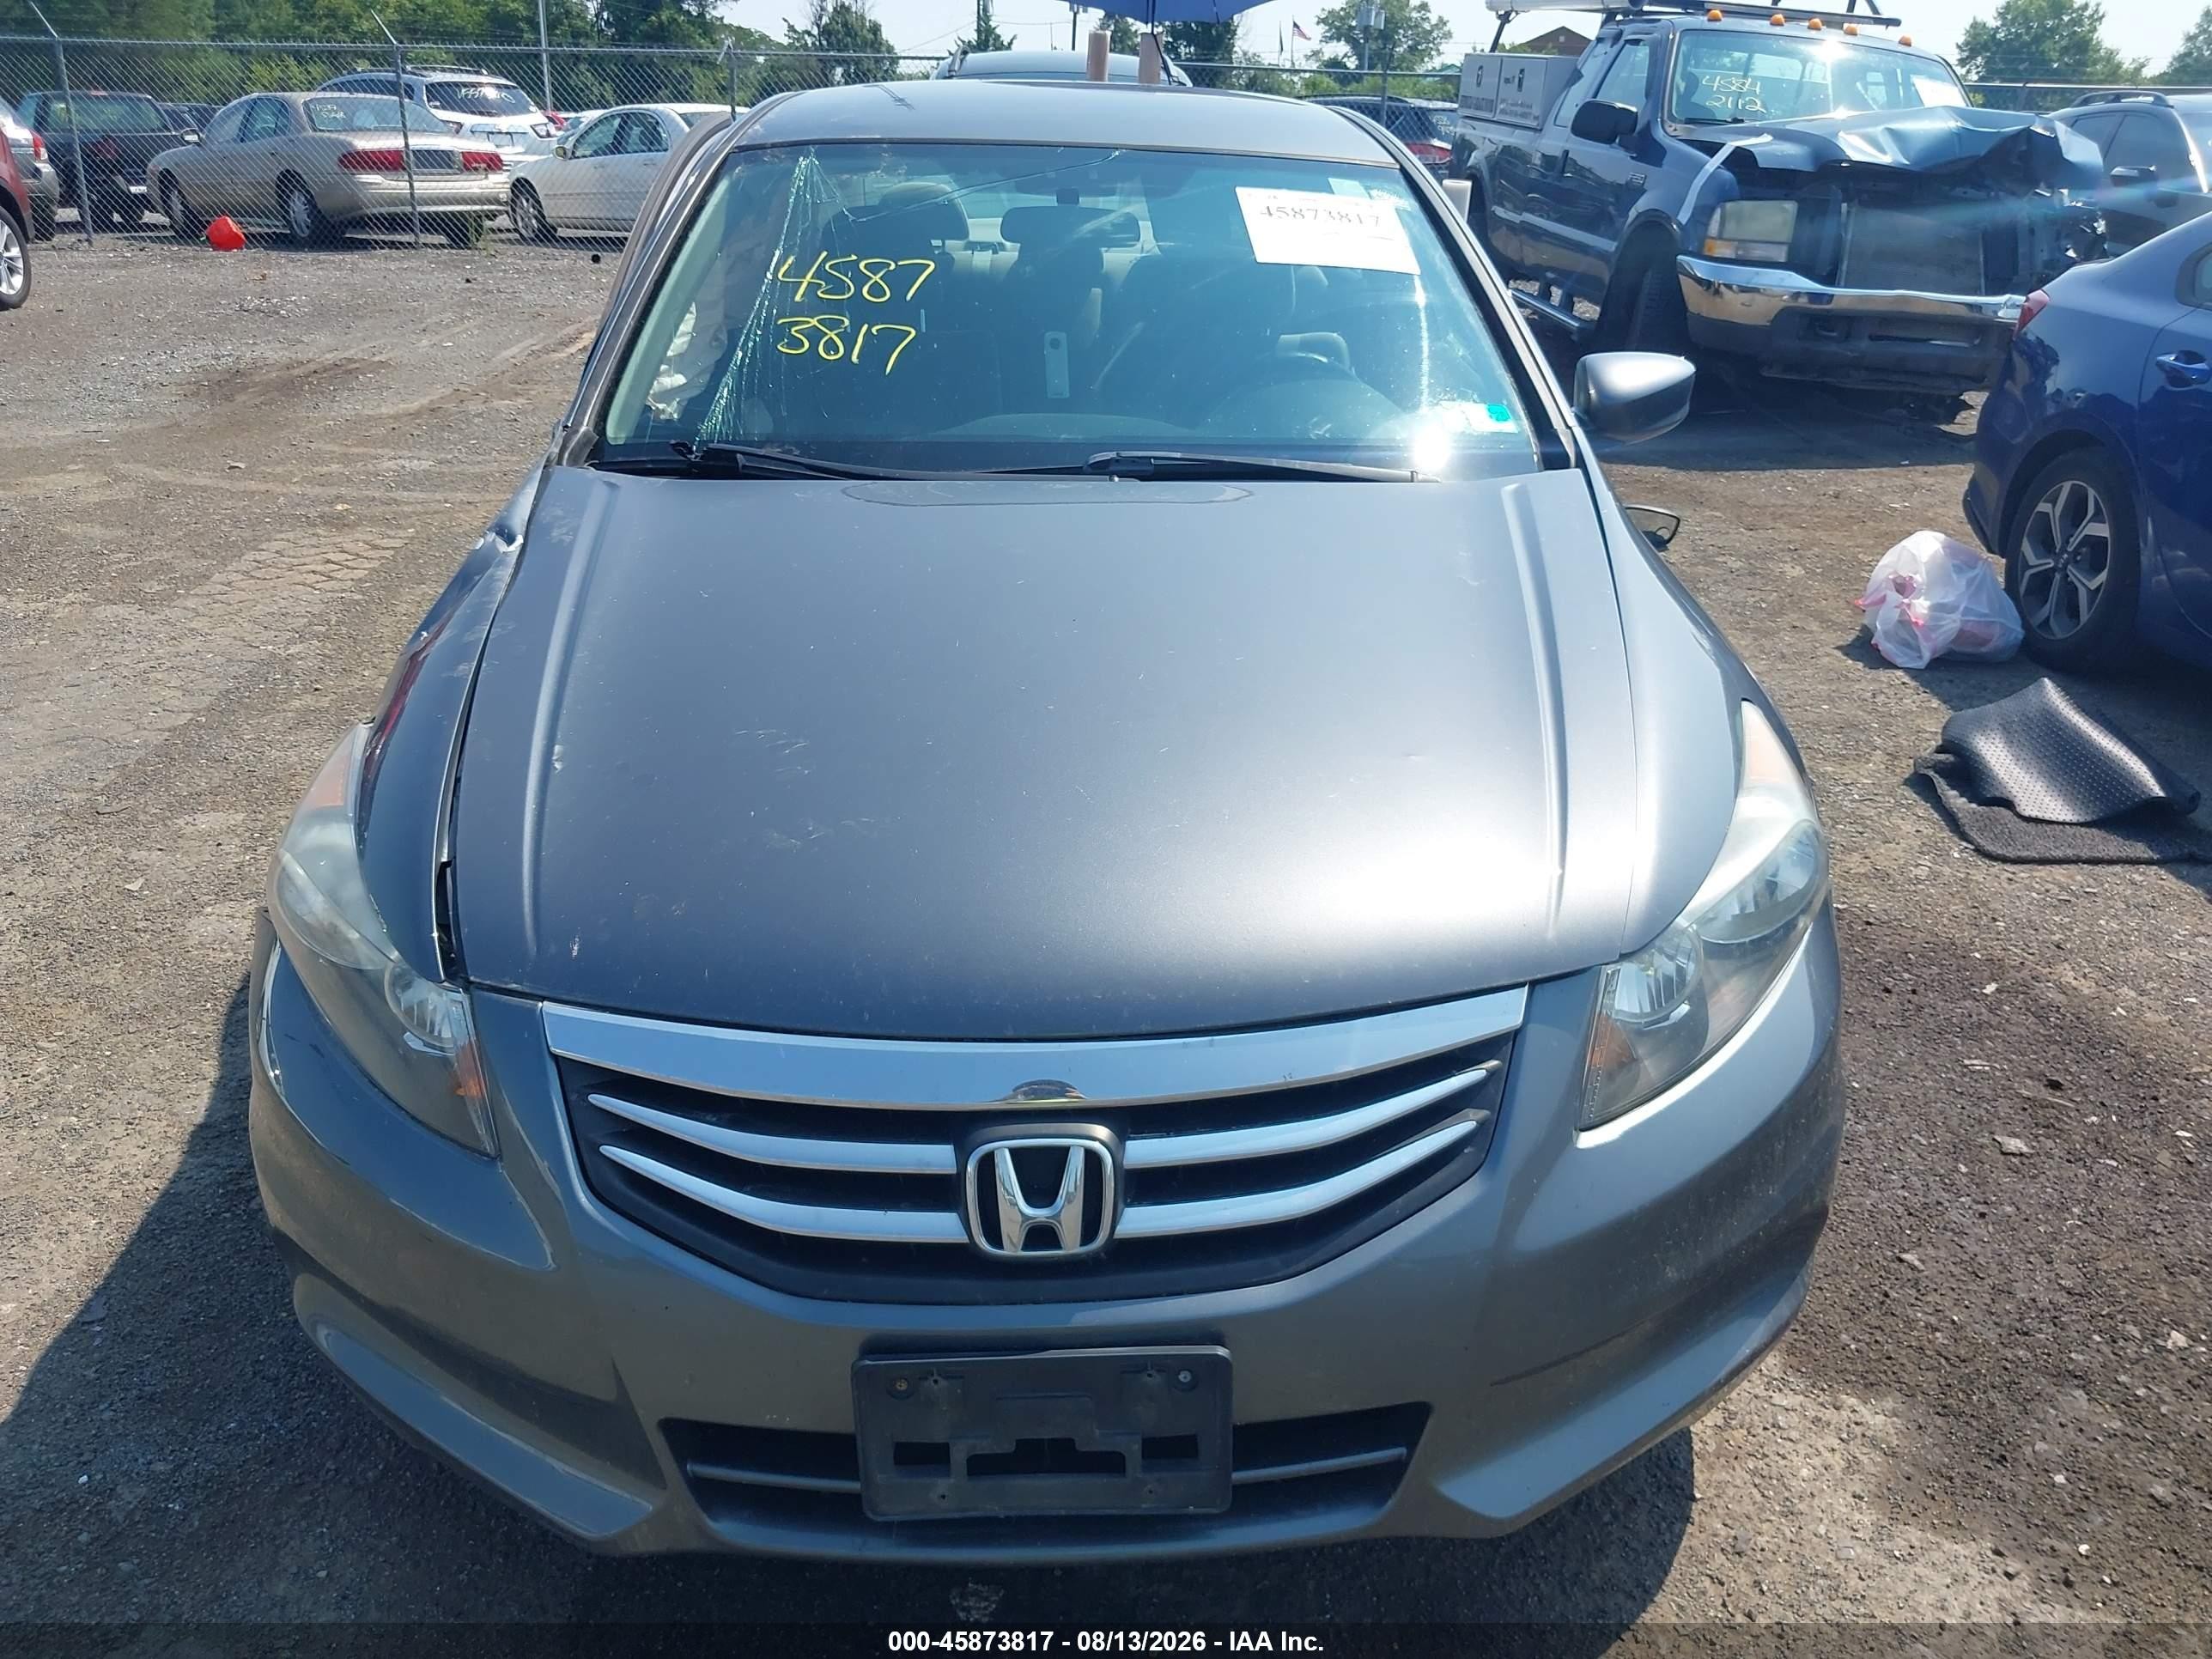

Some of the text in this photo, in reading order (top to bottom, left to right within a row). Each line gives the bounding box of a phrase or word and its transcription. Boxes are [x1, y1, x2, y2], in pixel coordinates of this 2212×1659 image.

[1702, 75, 1761, 94] 4584
[1705, 94, 1767, 114] 2112
[777, 251, 936, 302] 4587
[776, 314, 917, 376] 3817
